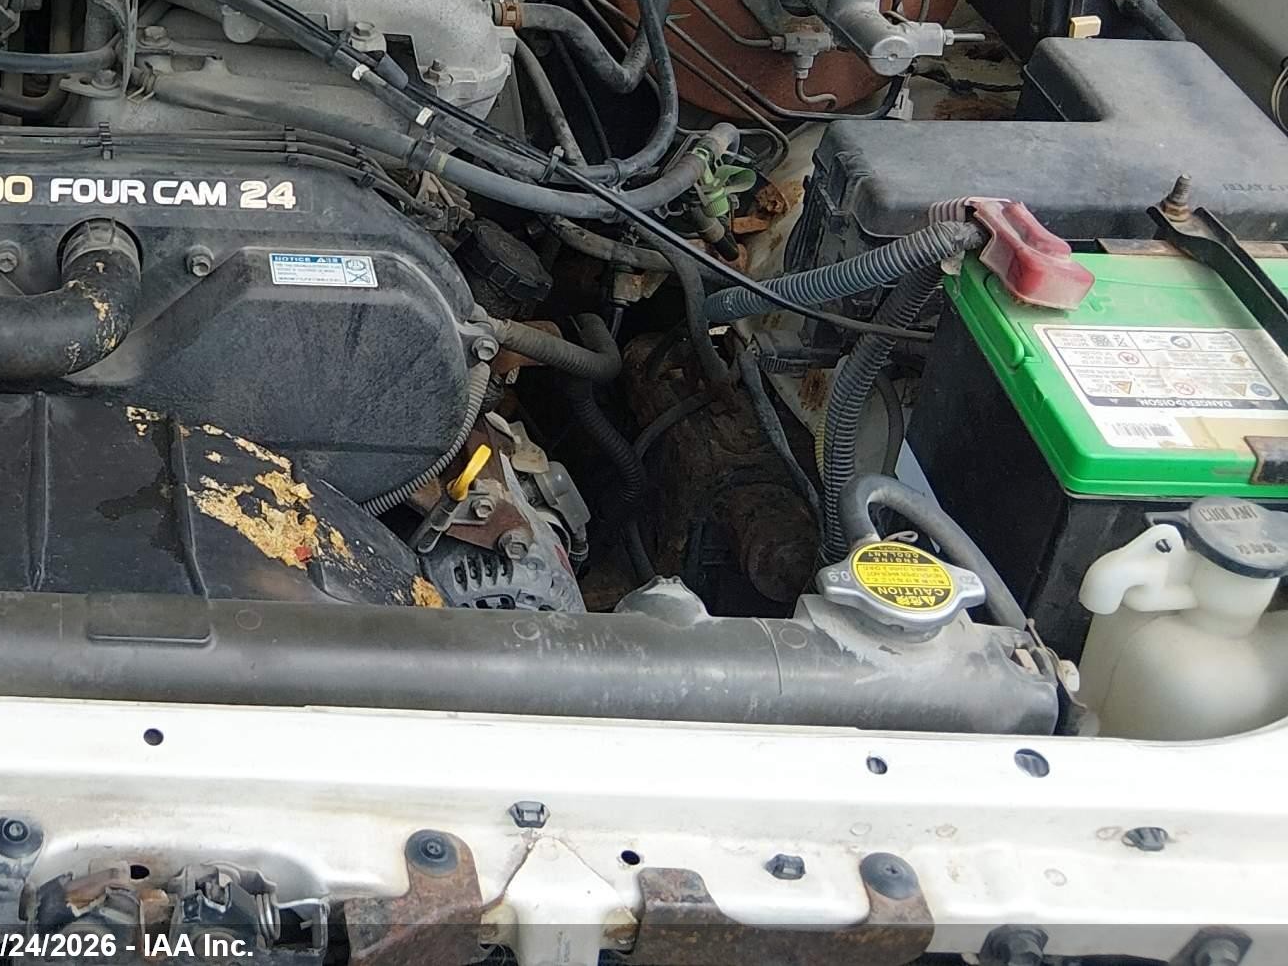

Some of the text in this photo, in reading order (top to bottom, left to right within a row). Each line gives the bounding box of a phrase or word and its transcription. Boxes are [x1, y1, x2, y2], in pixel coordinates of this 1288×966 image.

[49, 177, 147, 205] FOUR
[152, 180, 227, 207] CAM
[239, 181, 296, 209] 24
[878, 585, 946, 597] CAUTION
